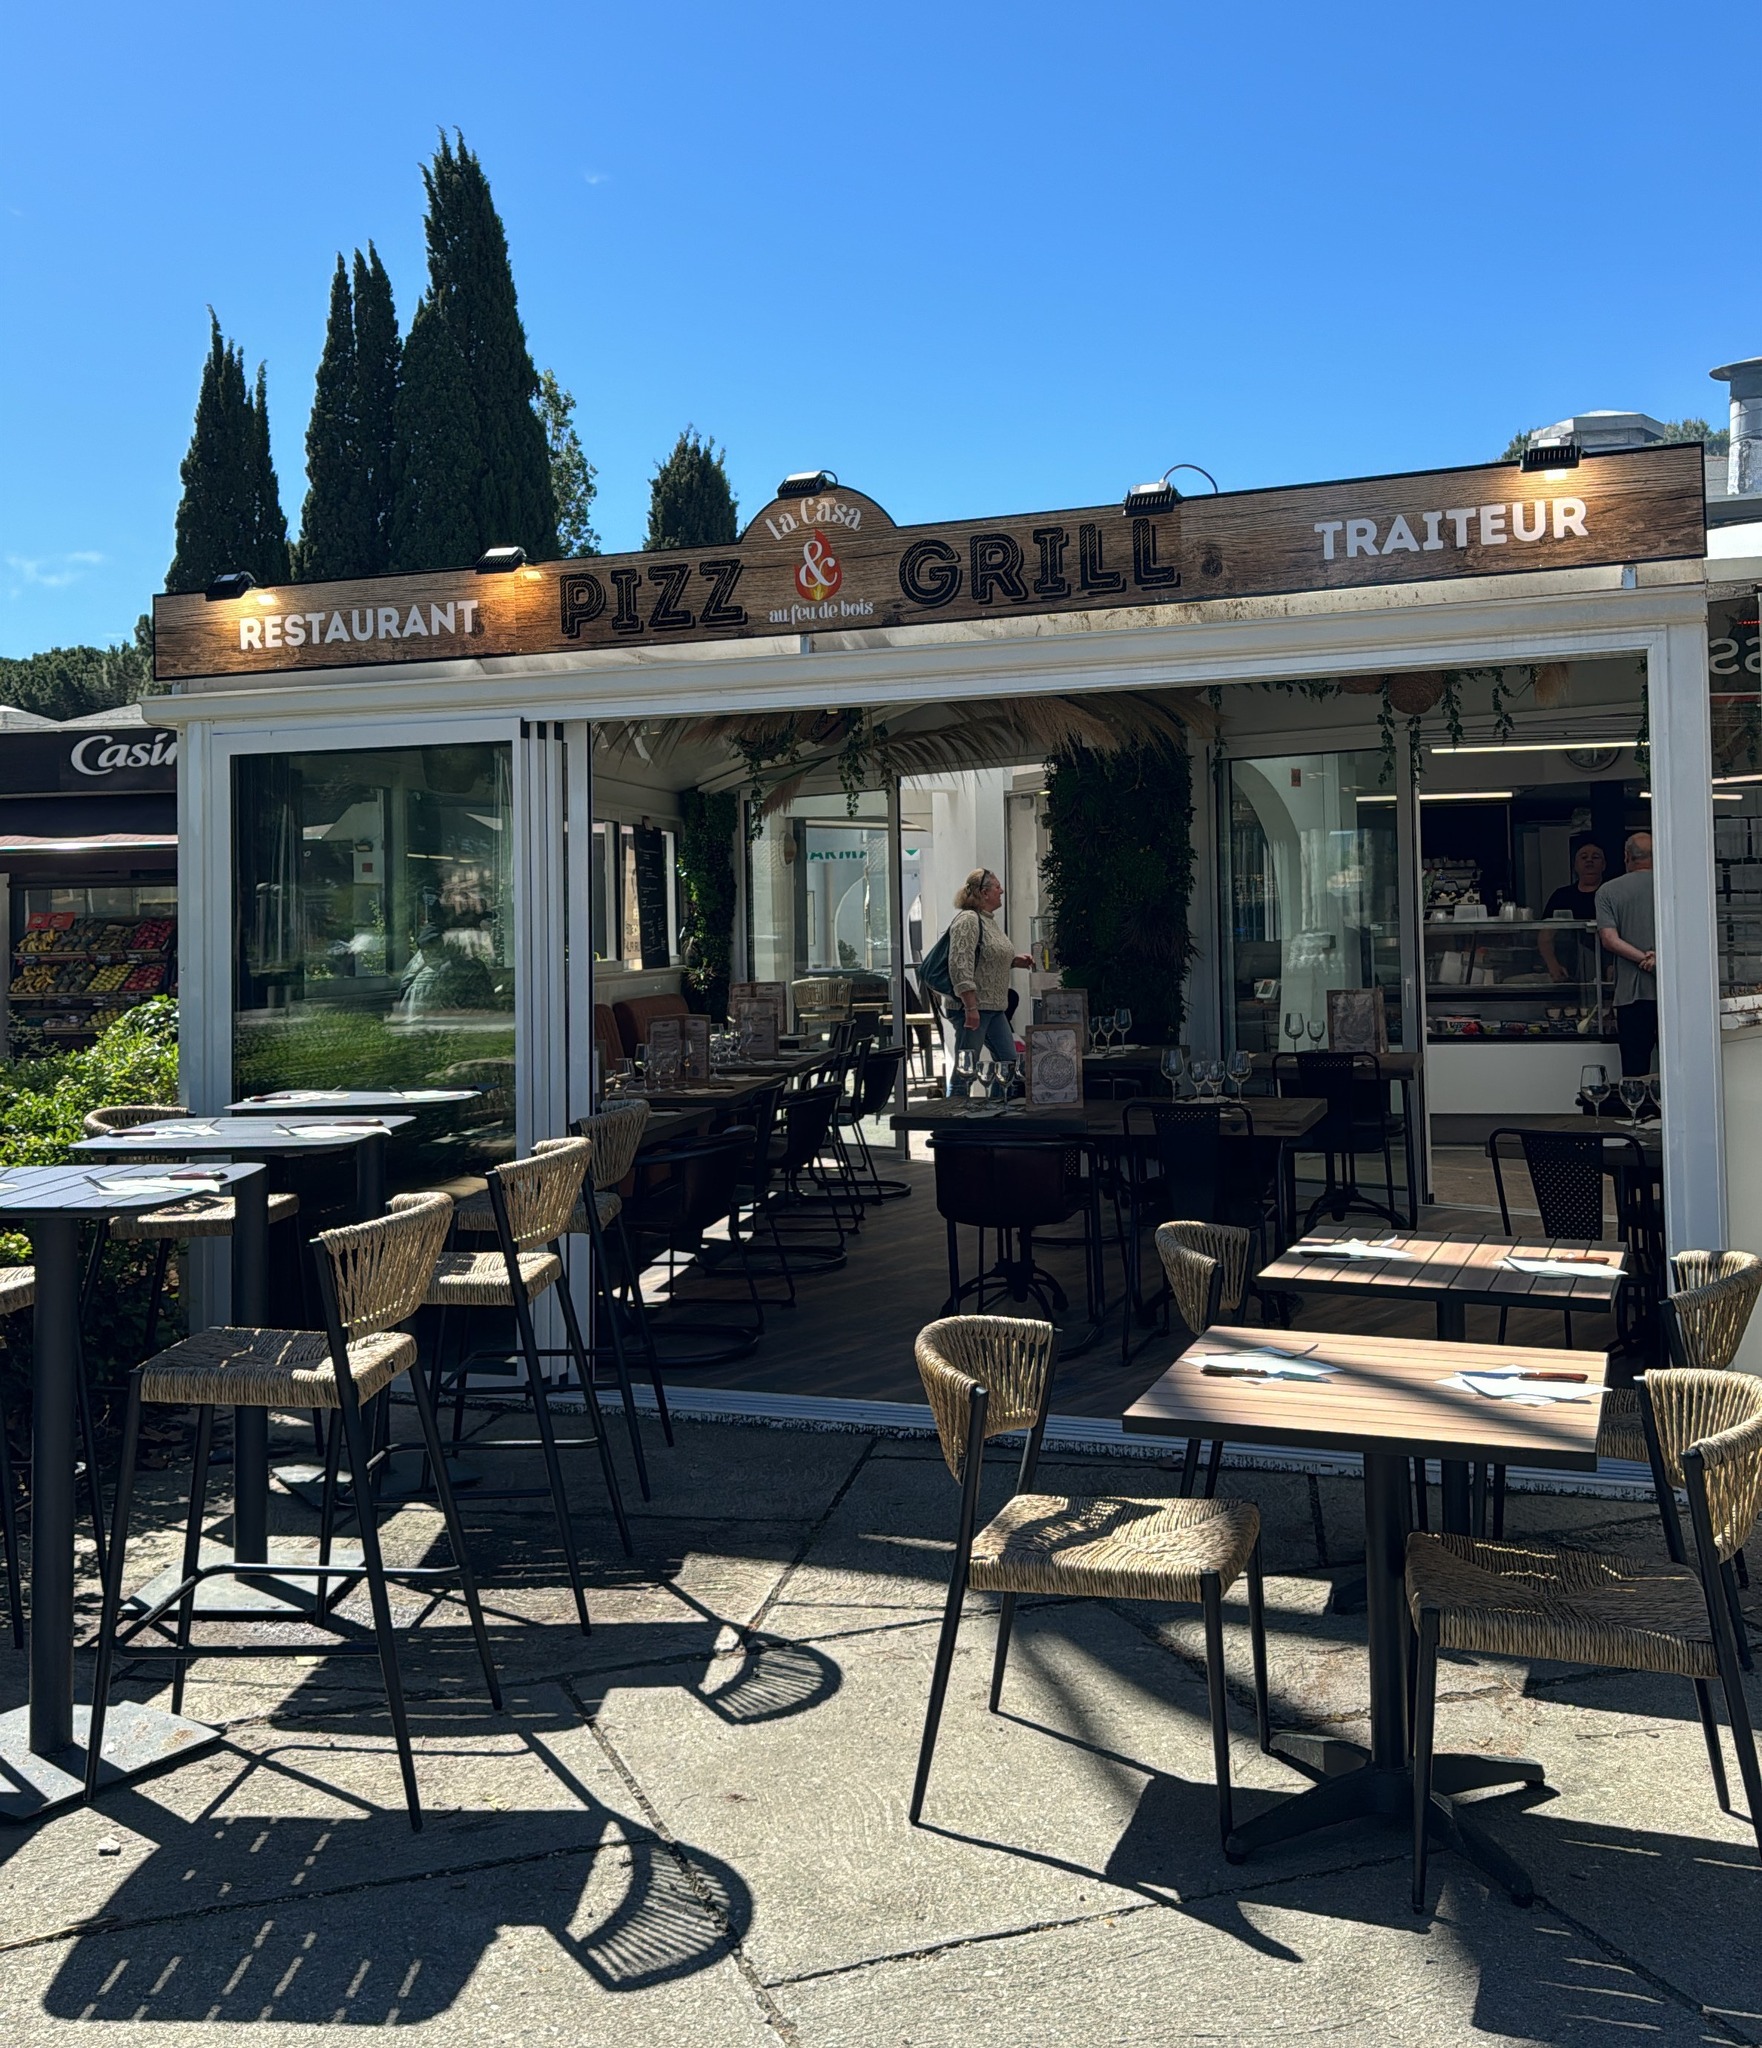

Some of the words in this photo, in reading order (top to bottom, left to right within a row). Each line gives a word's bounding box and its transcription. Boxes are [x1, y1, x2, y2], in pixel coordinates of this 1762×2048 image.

[800, 497, 862, 531] Casa
[1314, 497, 1589, 560] TRAITEUR
[560, 559, 749, 639] PIZZ
[799, 540, 838, 588] &
[899, 518, 1181, 608] GRILL
[239, 600, 479, 650] RESTAURANT
[769, 608, 790, 623] au
[790, 604, 818, 625] feu
[818, 602, 839, 619] de
[840, 598, 874, 617] bois
